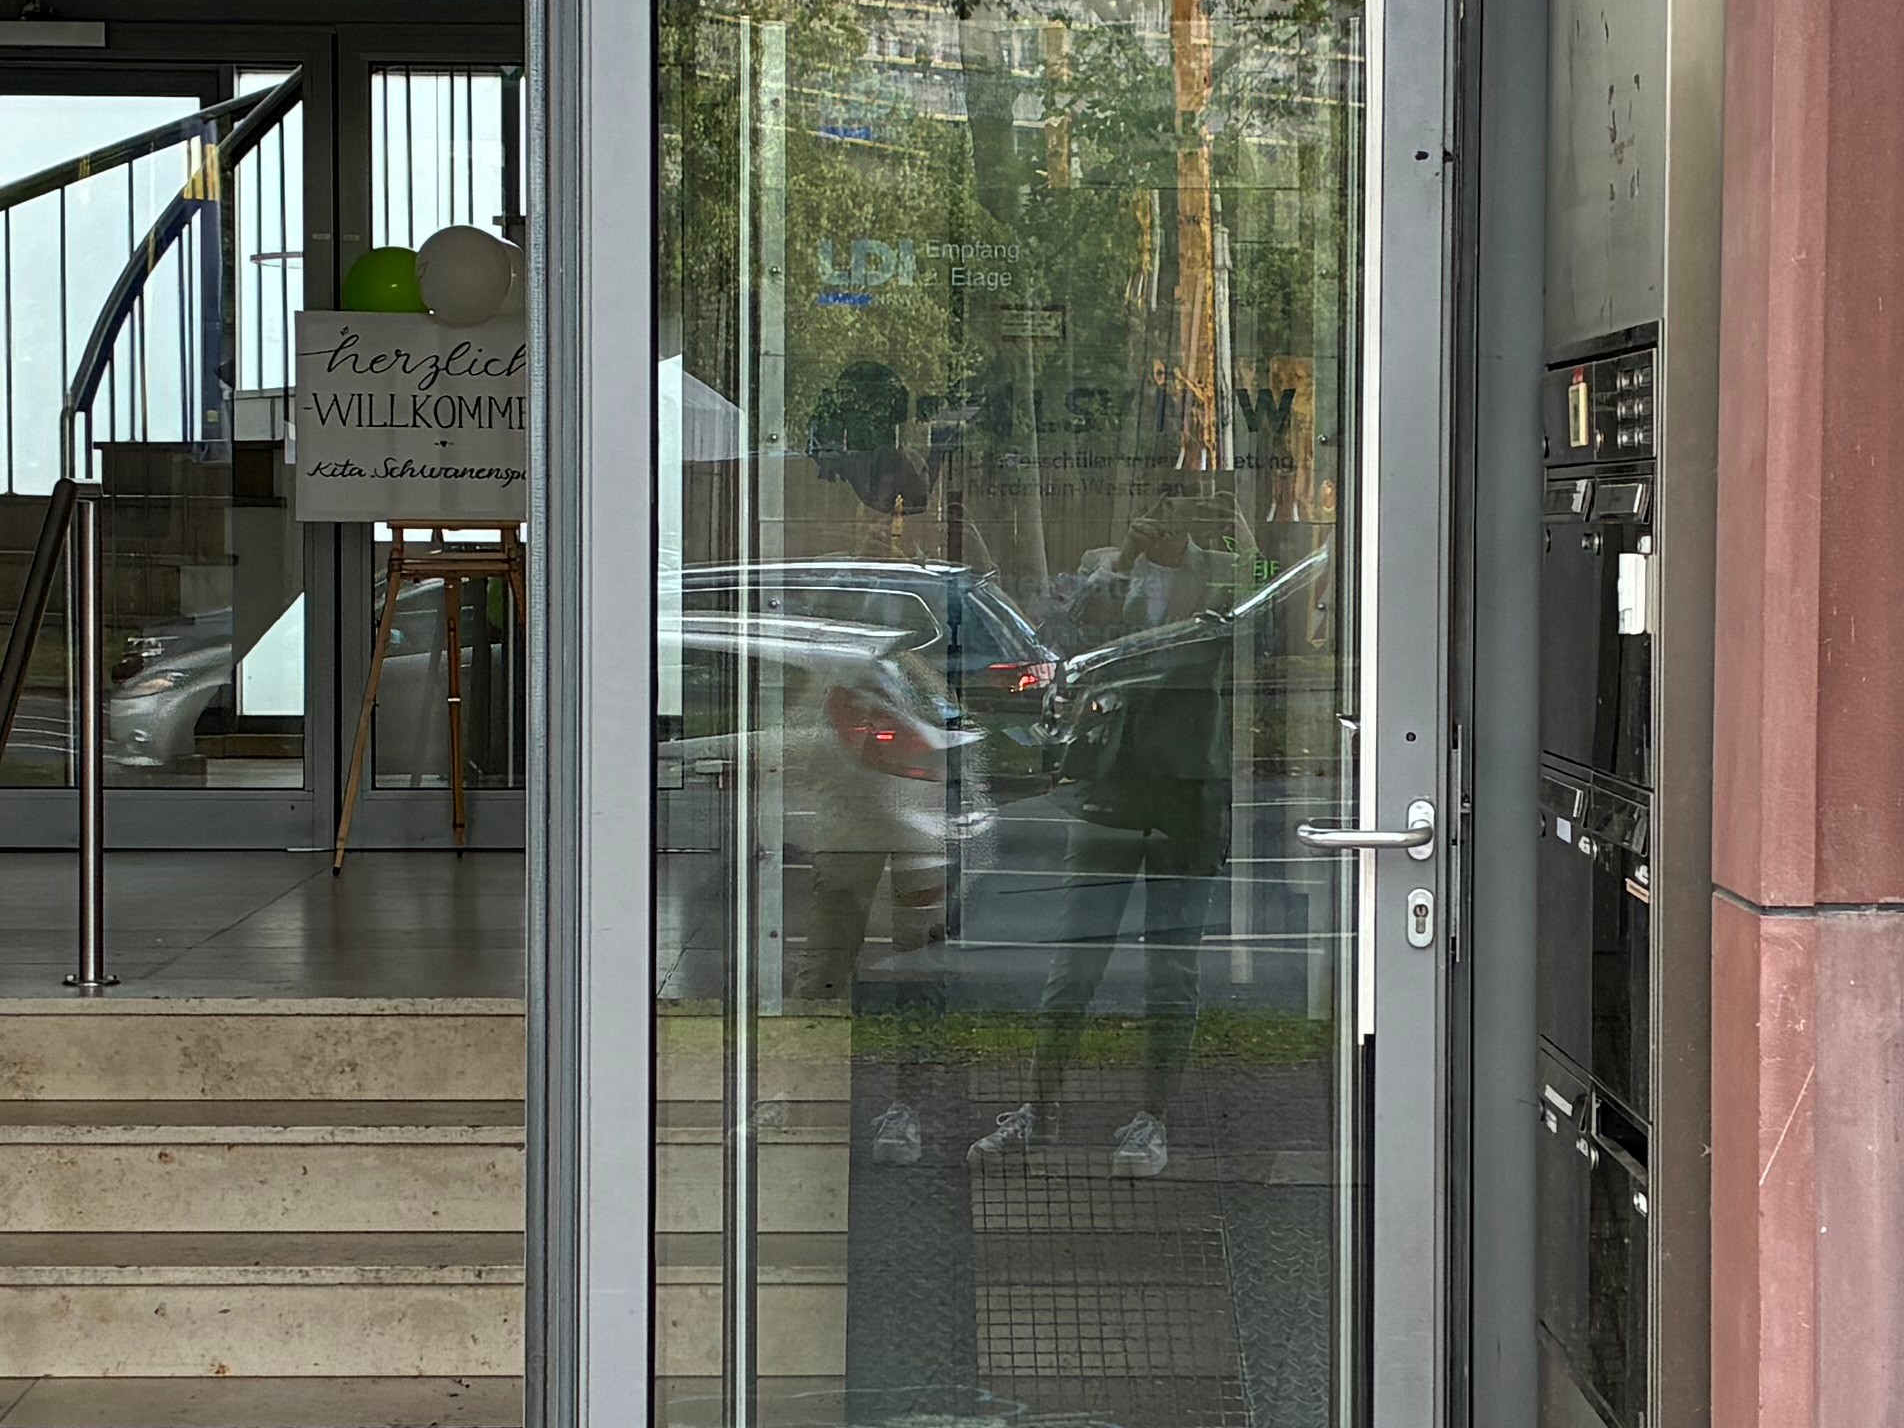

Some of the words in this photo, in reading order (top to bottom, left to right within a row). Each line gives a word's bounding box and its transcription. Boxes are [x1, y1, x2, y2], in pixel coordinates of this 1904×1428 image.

[817, 238, 916, 286] LDI
[926, 239, 1019, 263] Empfang
[951, 267, 1012, 291] Etage
